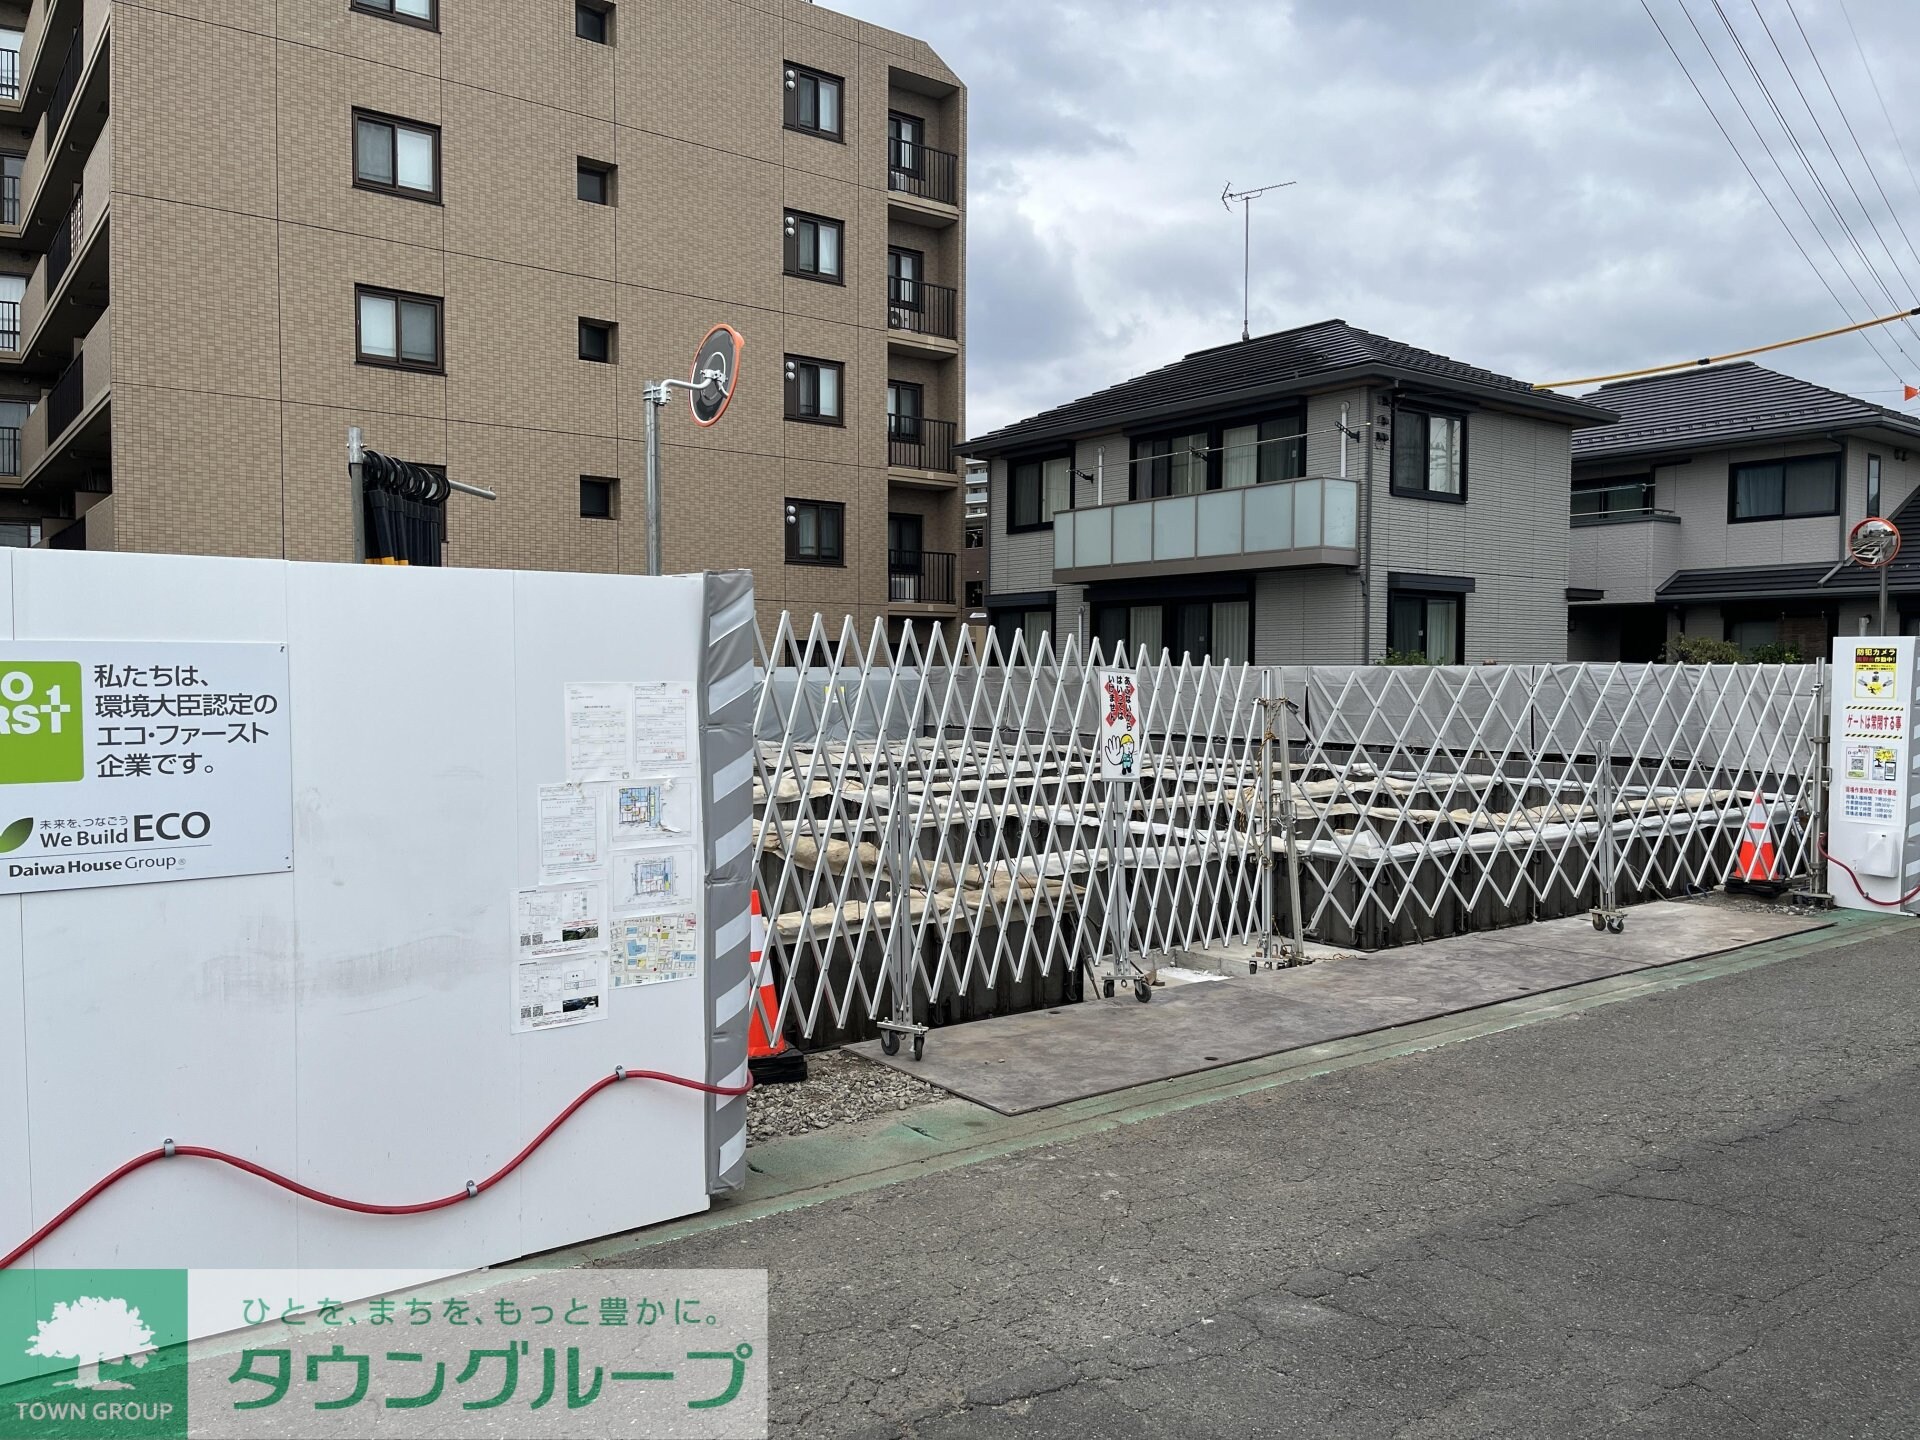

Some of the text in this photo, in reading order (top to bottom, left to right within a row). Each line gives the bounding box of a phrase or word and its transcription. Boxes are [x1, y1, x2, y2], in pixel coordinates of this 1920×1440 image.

[94, 664, 209, 689] 私たちは、
[95, 693, 278, 718] 環境大臣認定の
[1108, 674, 1116, 721] いけません
[1116, 675, 1124, 720] はいっては
[1124, 676, 1133, 732] あぶないから
[97, 722, 269, 746] エコ・ファースト
[1847, 713, 1902, 731] ゲートは常閉する事
[96, 752, 214, 778] 企業です。
[39, 815, 129, 830] 未来を、つなごう
[40, 811, 211, 848] We Build ECO
[9, 862, 65, 878] Daiwa
[68, 859, 123, 874] House
